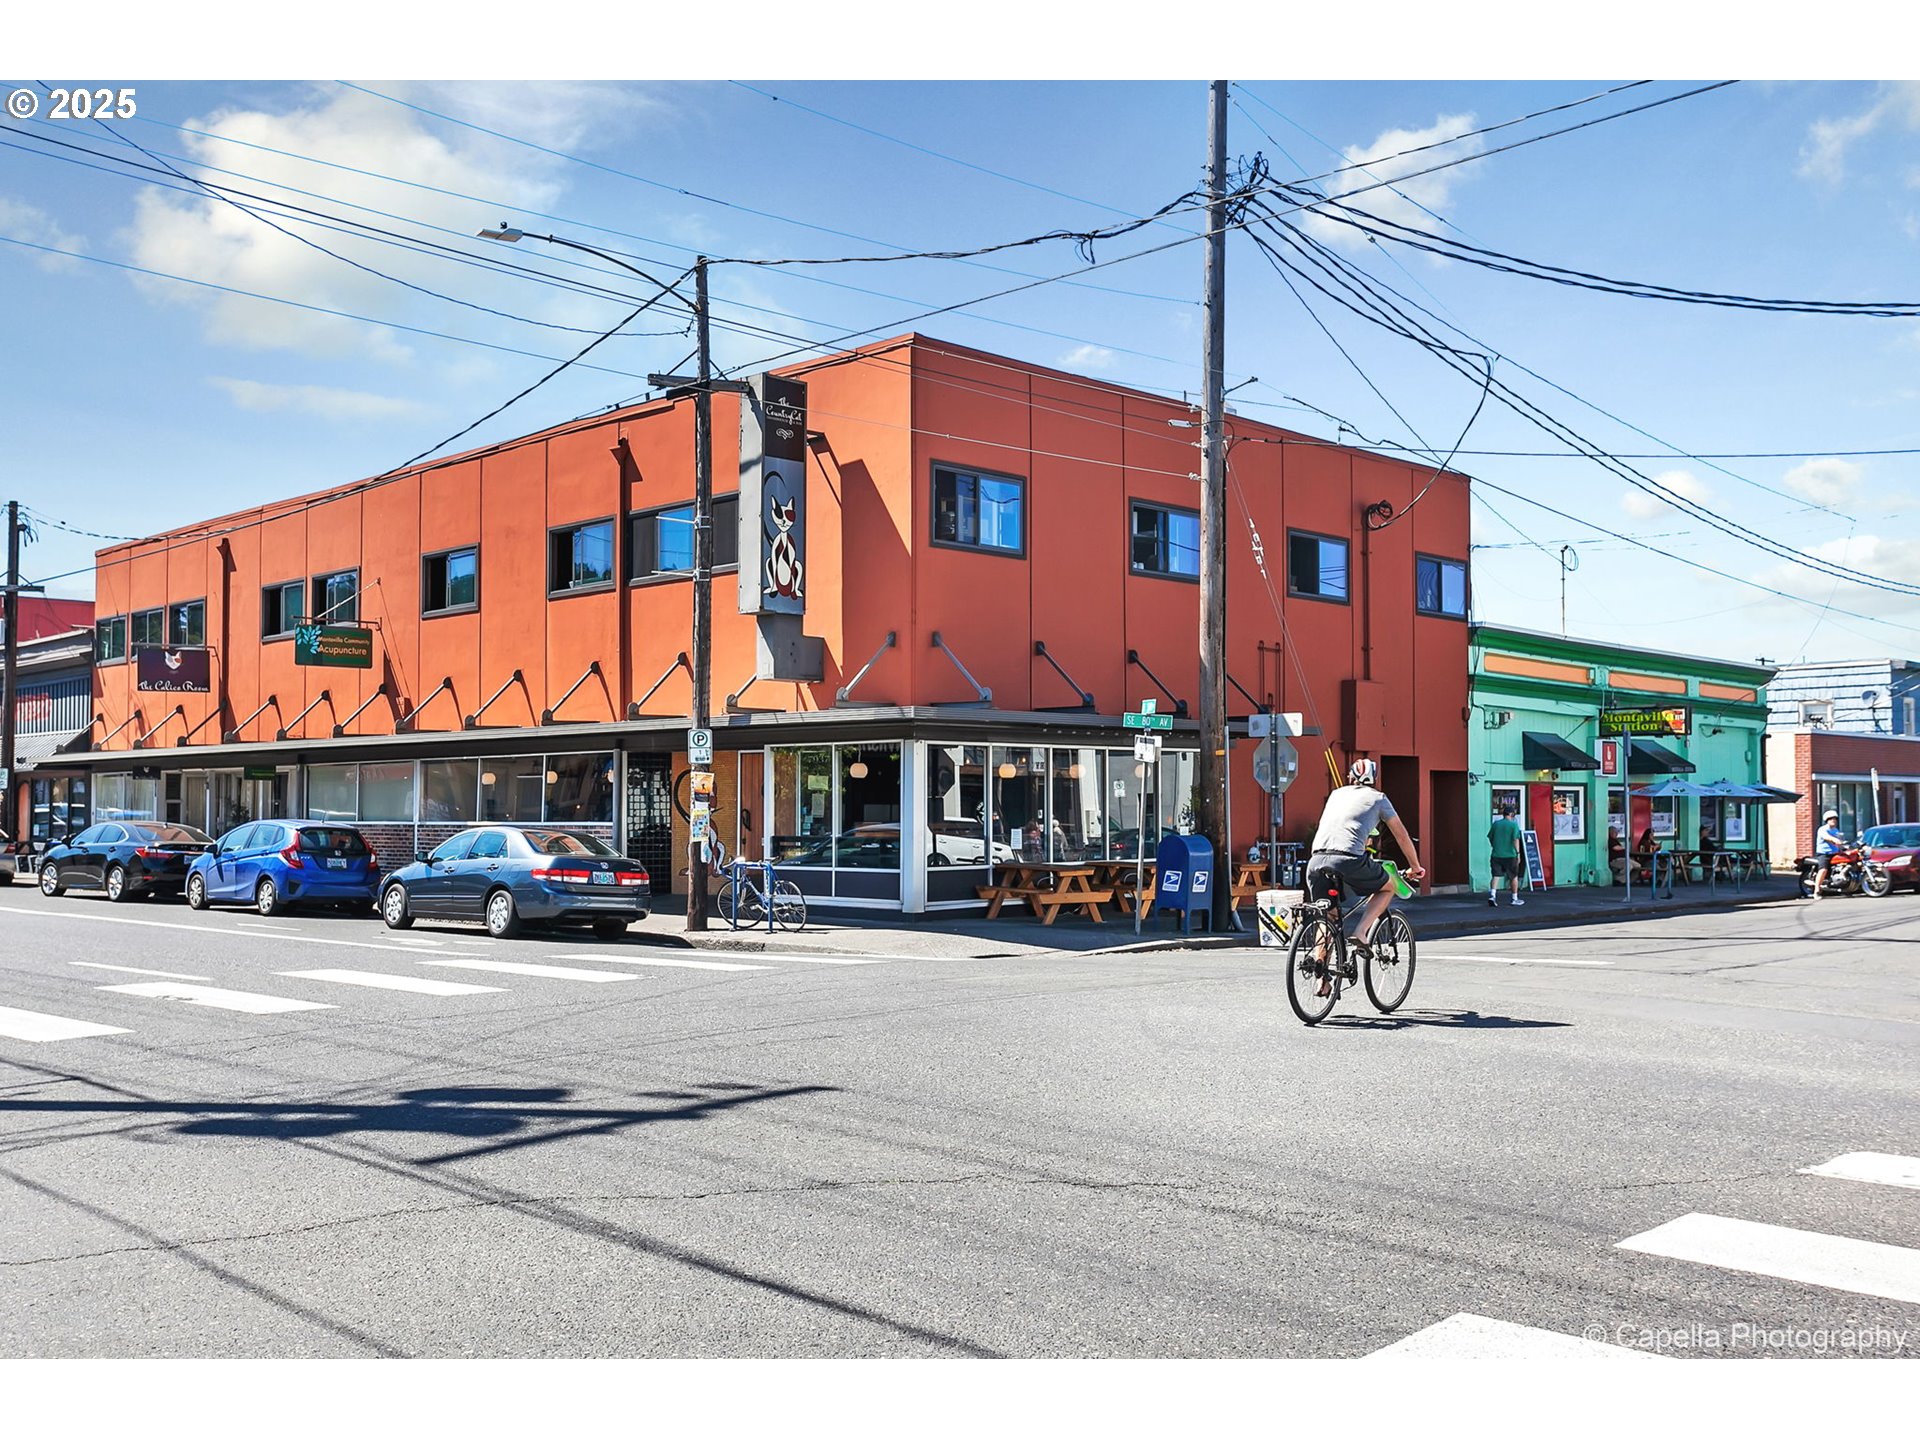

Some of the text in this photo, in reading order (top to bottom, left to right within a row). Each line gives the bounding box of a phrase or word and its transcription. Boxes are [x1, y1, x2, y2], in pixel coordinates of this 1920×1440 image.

[778, 396, 790, 406] The
[343, 637, 370, 646] Community
[317, 644, 367, 656] Acupuncture
[138, 680, 209, 692] The Calico Room
[1126, 715, 1135, 725] SE
[1159, 717, 1169, 727] AV
[1602, 711, 1675, 723] Montavilla
[697, 734, 705, 744] P
